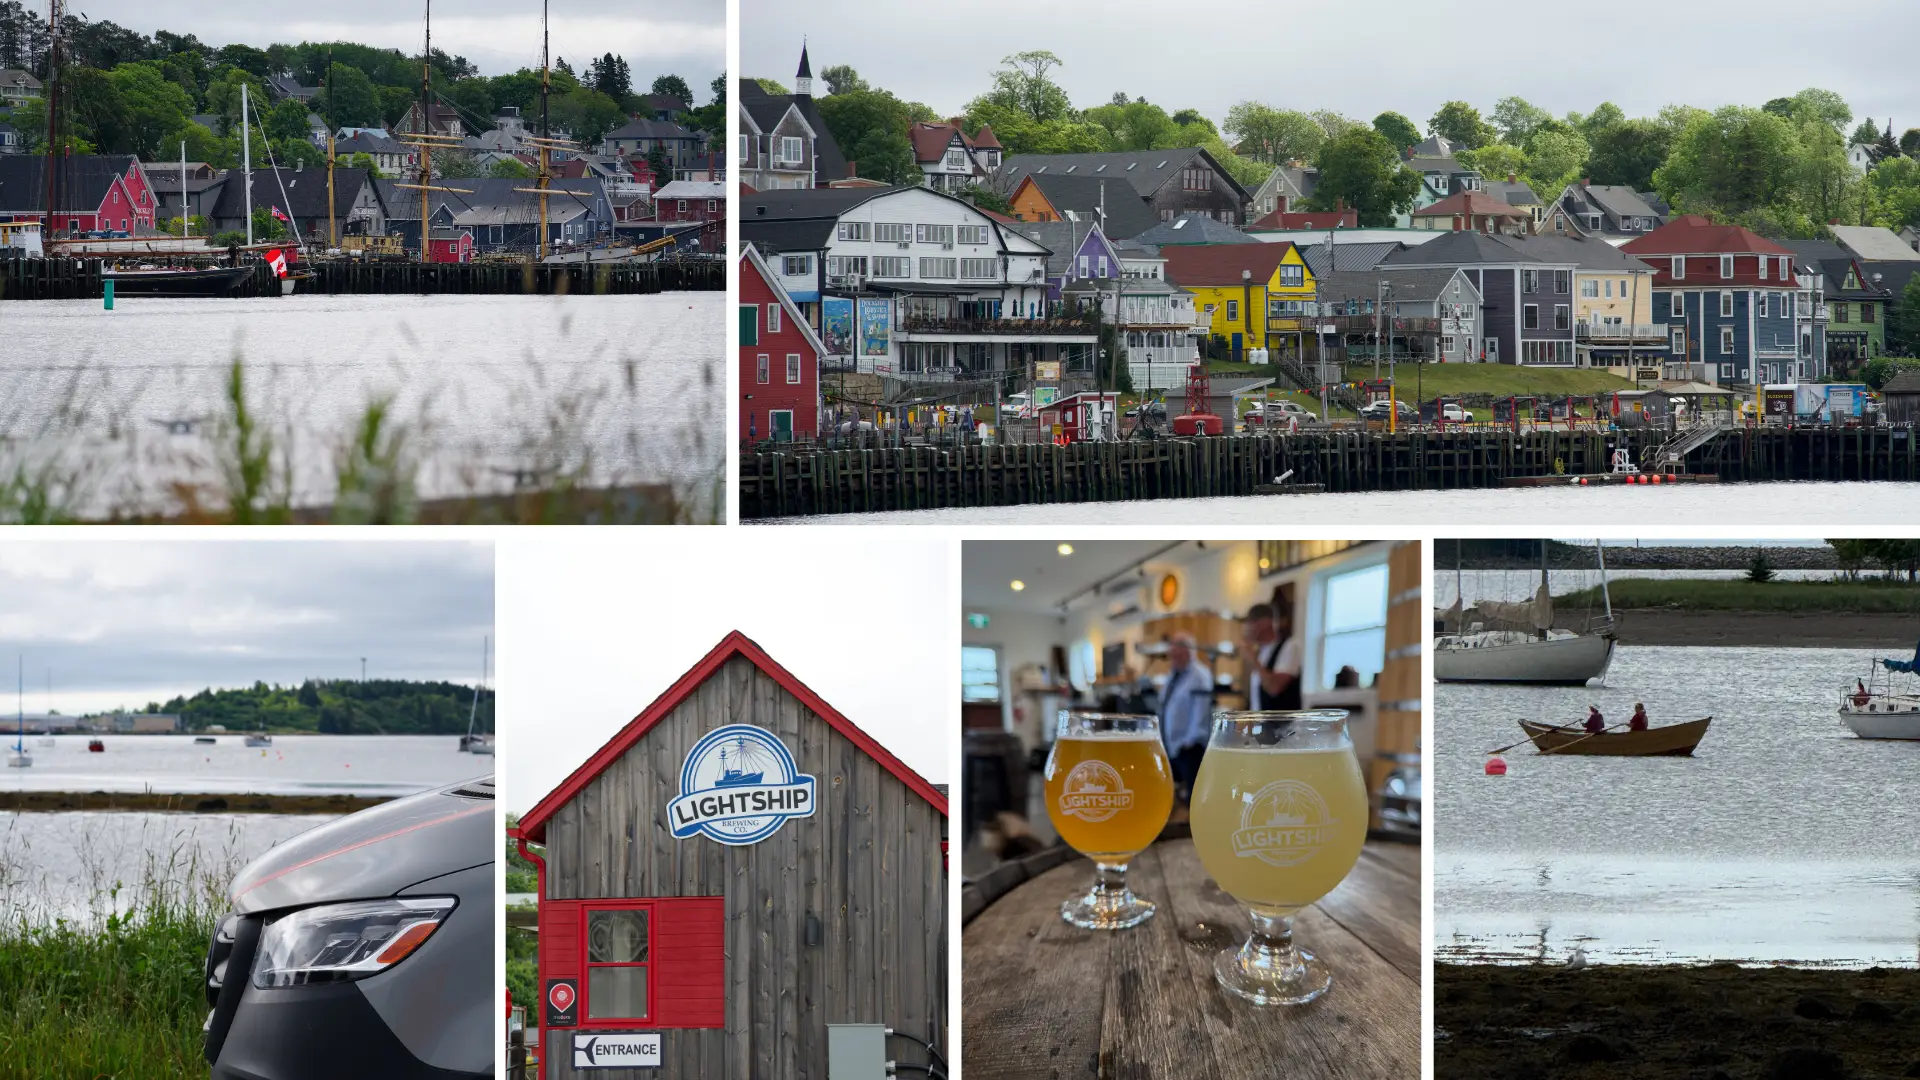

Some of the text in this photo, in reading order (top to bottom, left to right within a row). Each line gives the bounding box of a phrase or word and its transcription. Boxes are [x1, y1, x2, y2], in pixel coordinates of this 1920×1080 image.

[675, 788, 809, 824] LIGHTSHIP
[1062, 795, 1131, 809] LIGHTSHIP
[595, 1043, 657, 1056] ENTRANCE
